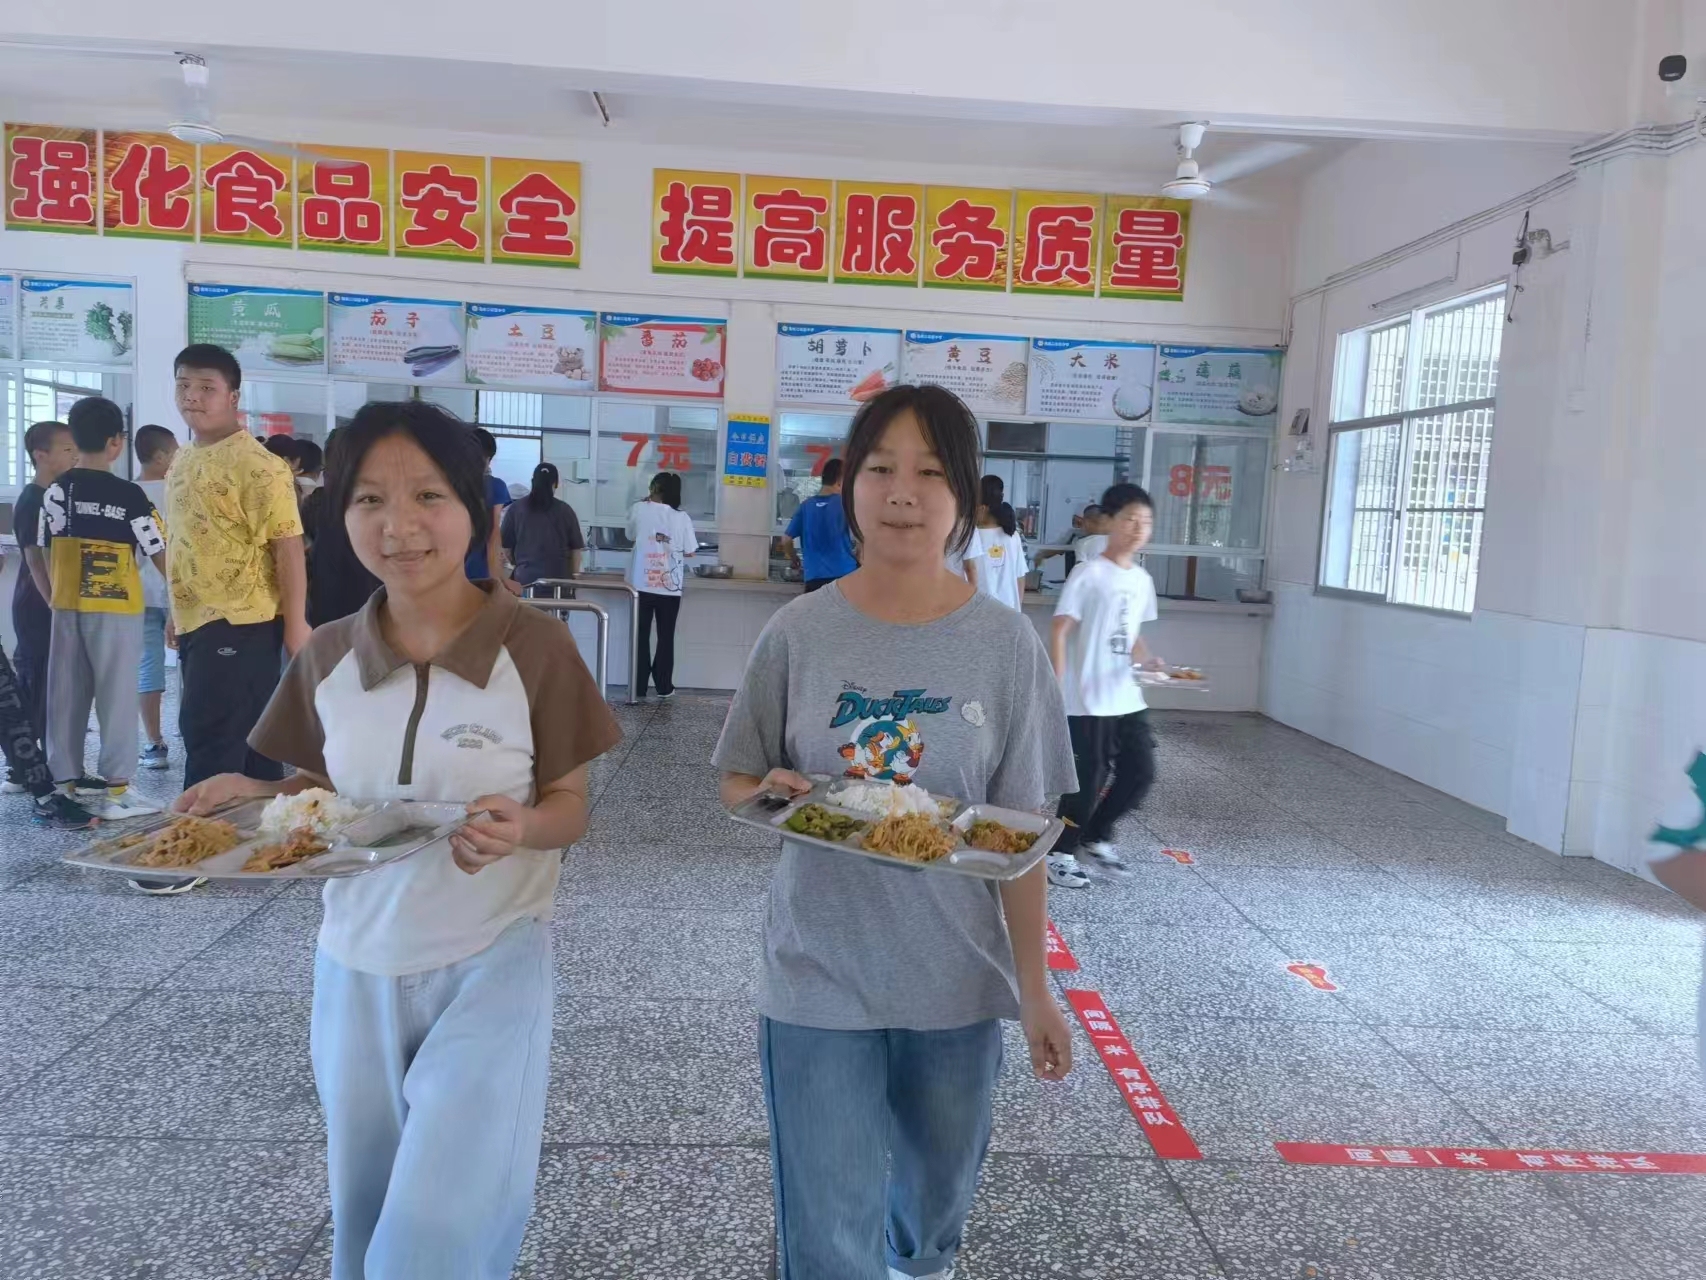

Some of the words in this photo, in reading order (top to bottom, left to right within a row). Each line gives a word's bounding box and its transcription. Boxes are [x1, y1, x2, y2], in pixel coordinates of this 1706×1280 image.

[10, 136, 576, 257] 强化食品安全
[659, 182, 1183, 292] 提高服务质量
[232, 299, 281, 318] 黄瓜
[370, 308, 420, 328] 茄子
[508, 323, 555, 341] 土豆
[641, 329, 688, 349] 番茄
[807, 338, 872, 357] 胡萝卜
[947, 345, 993, 364] 黄豆
[1070, 352, 1120, 370] 大米
[620, 432, 692, 472] 7元
[1168, 464, 1232, 500] 8元
[1082, 1009, 1129, 1056] 间隔一米
[1344, 1148, 1488, 1167] 间隔一米
